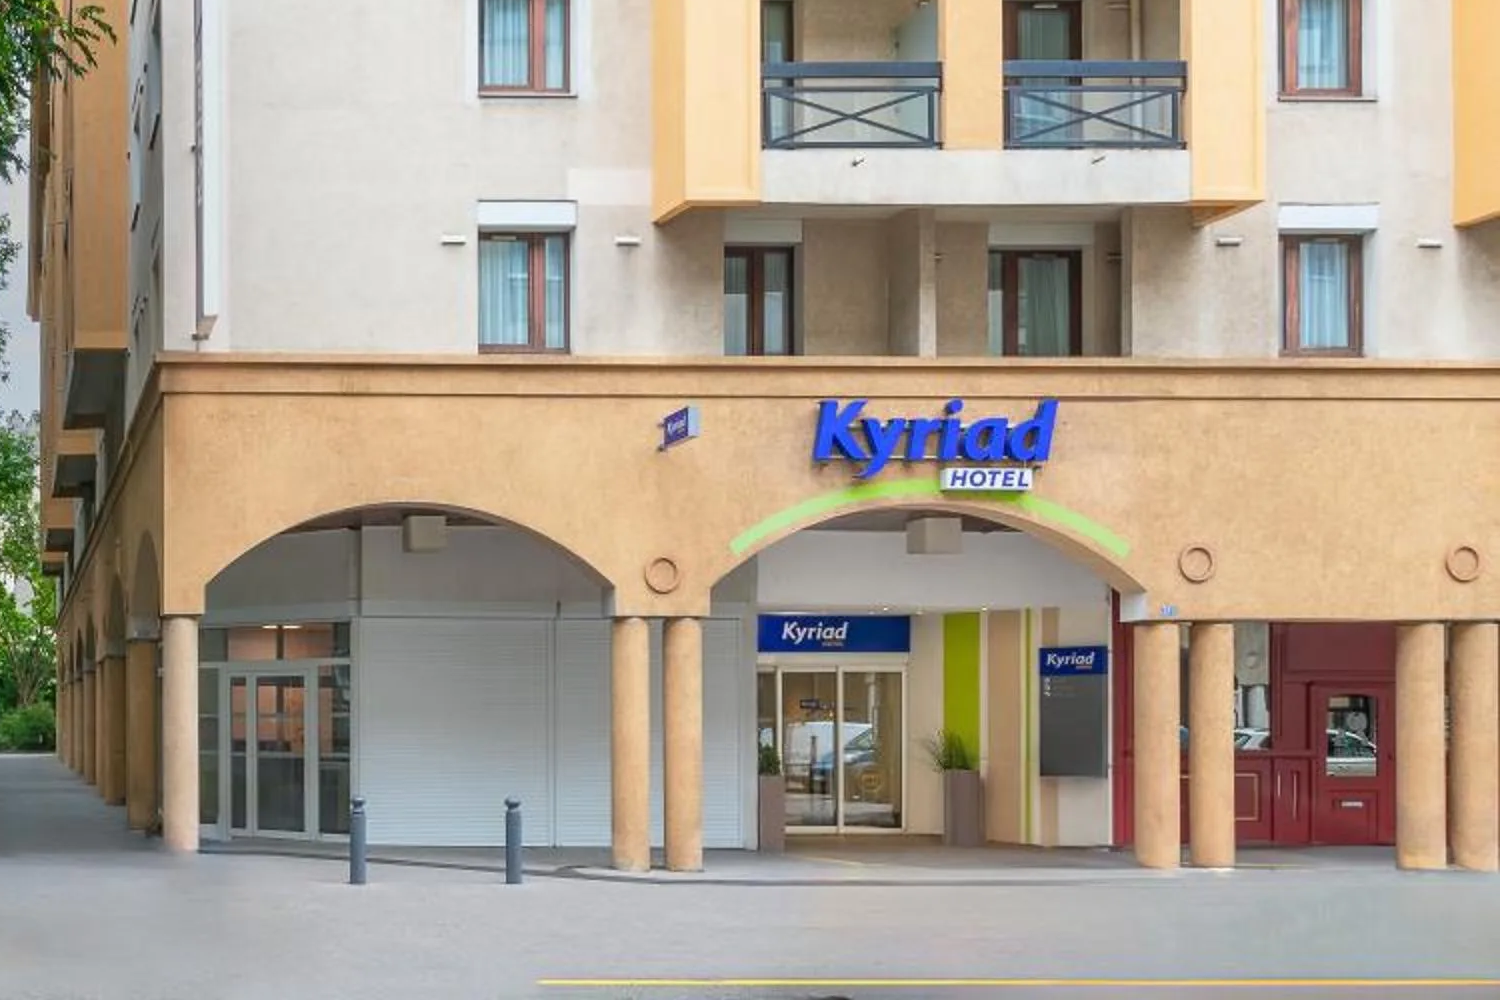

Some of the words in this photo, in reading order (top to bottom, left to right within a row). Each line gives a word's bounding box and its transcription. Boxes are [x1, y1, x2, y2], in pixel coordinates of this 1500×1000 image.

[814, 397, 1059, 478] Kyriad
[949, 469, 1029, 488] HOTEL
[781, 621, 849, 645] Kyriad
[1046, 651, 1095, 669] Kyriad
